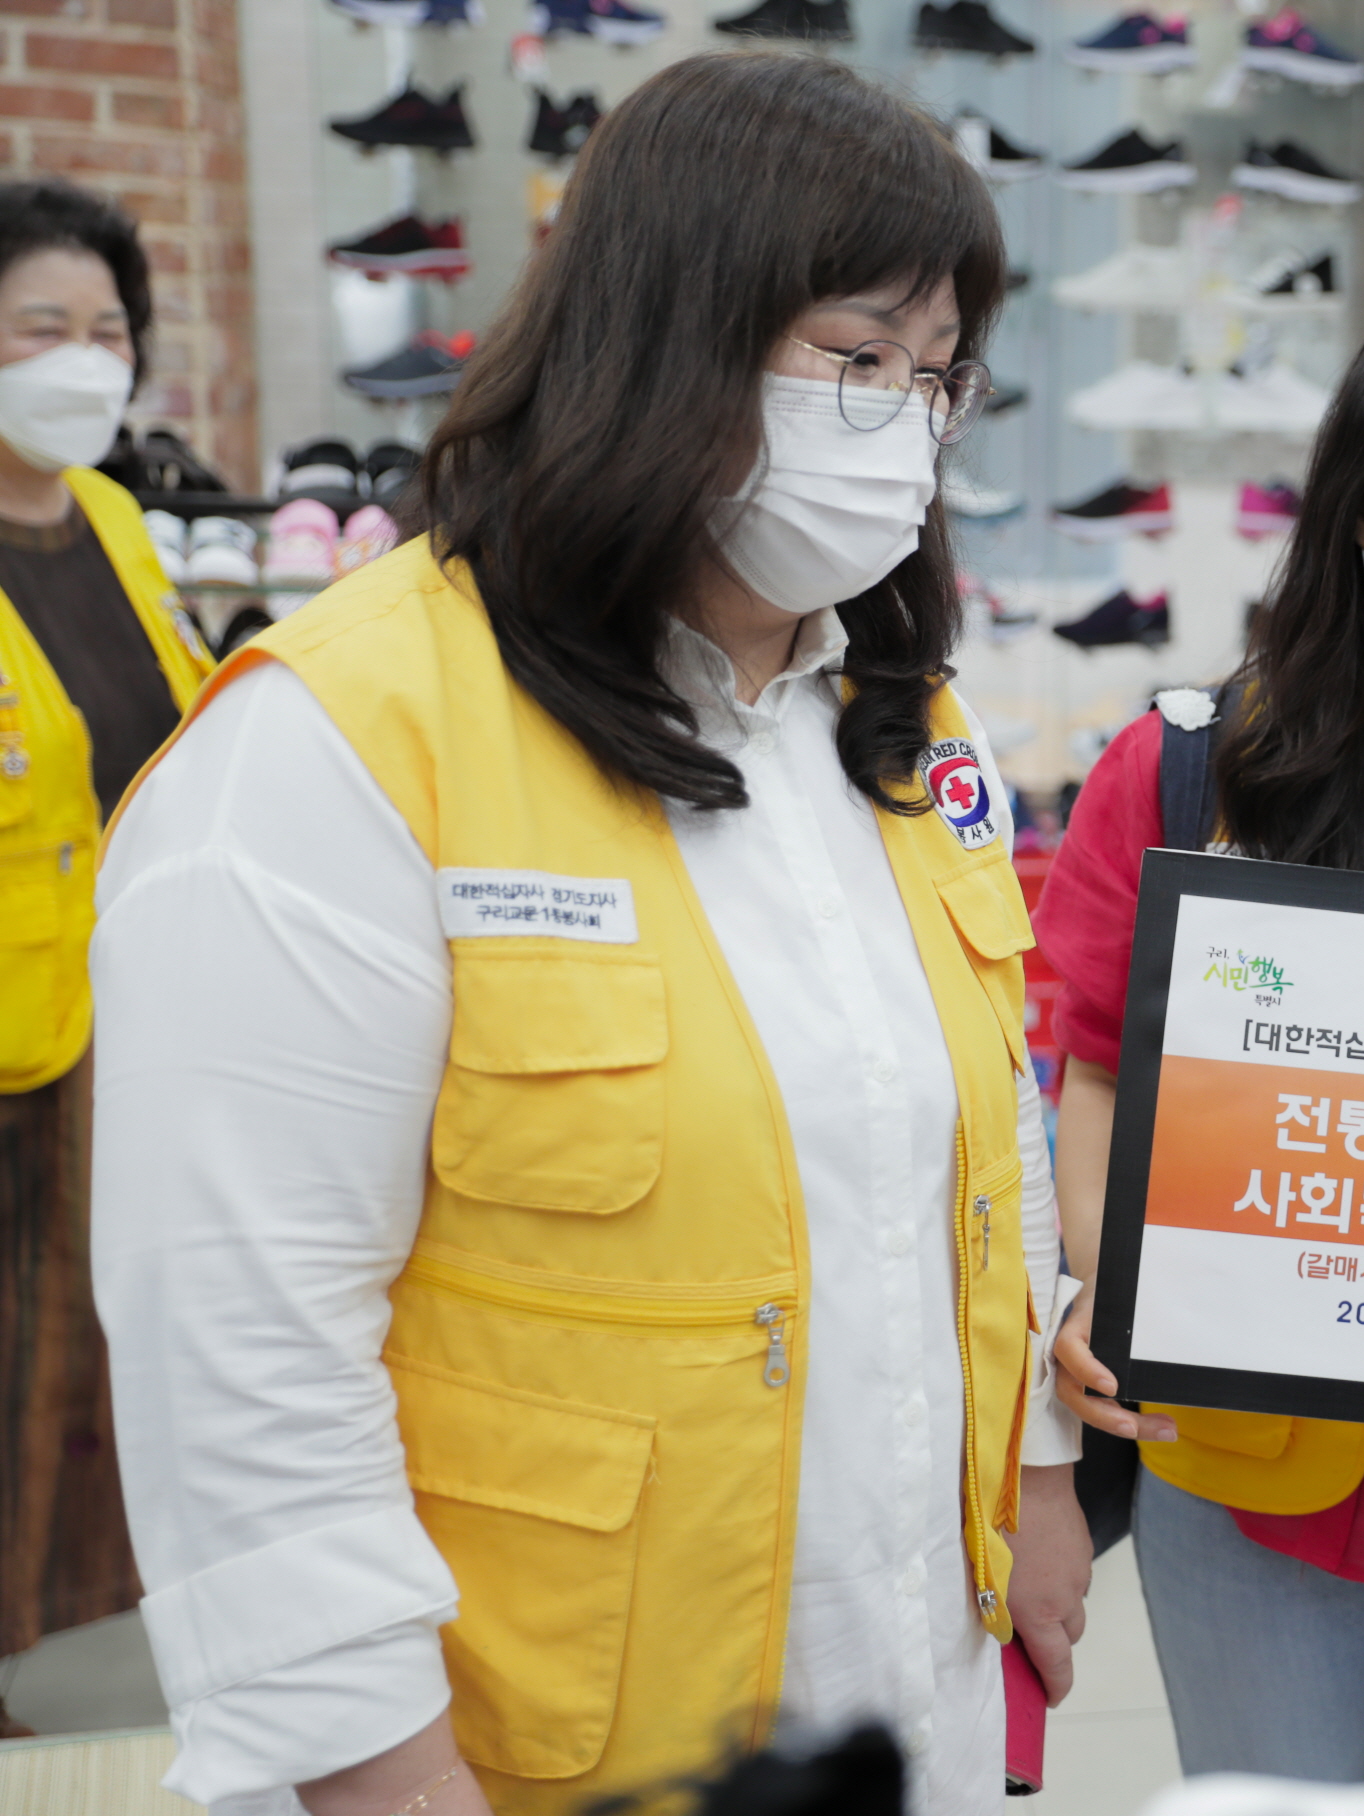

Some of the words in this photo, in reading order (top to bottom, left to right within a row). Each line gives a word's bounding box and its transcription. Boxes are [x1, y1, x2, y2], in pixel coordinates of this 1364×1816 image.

[933, 742, 957, 761] RED
[452, 882, 545, 899] 대한적십자사
[1254, 994, 1281, 1008] 특별시
